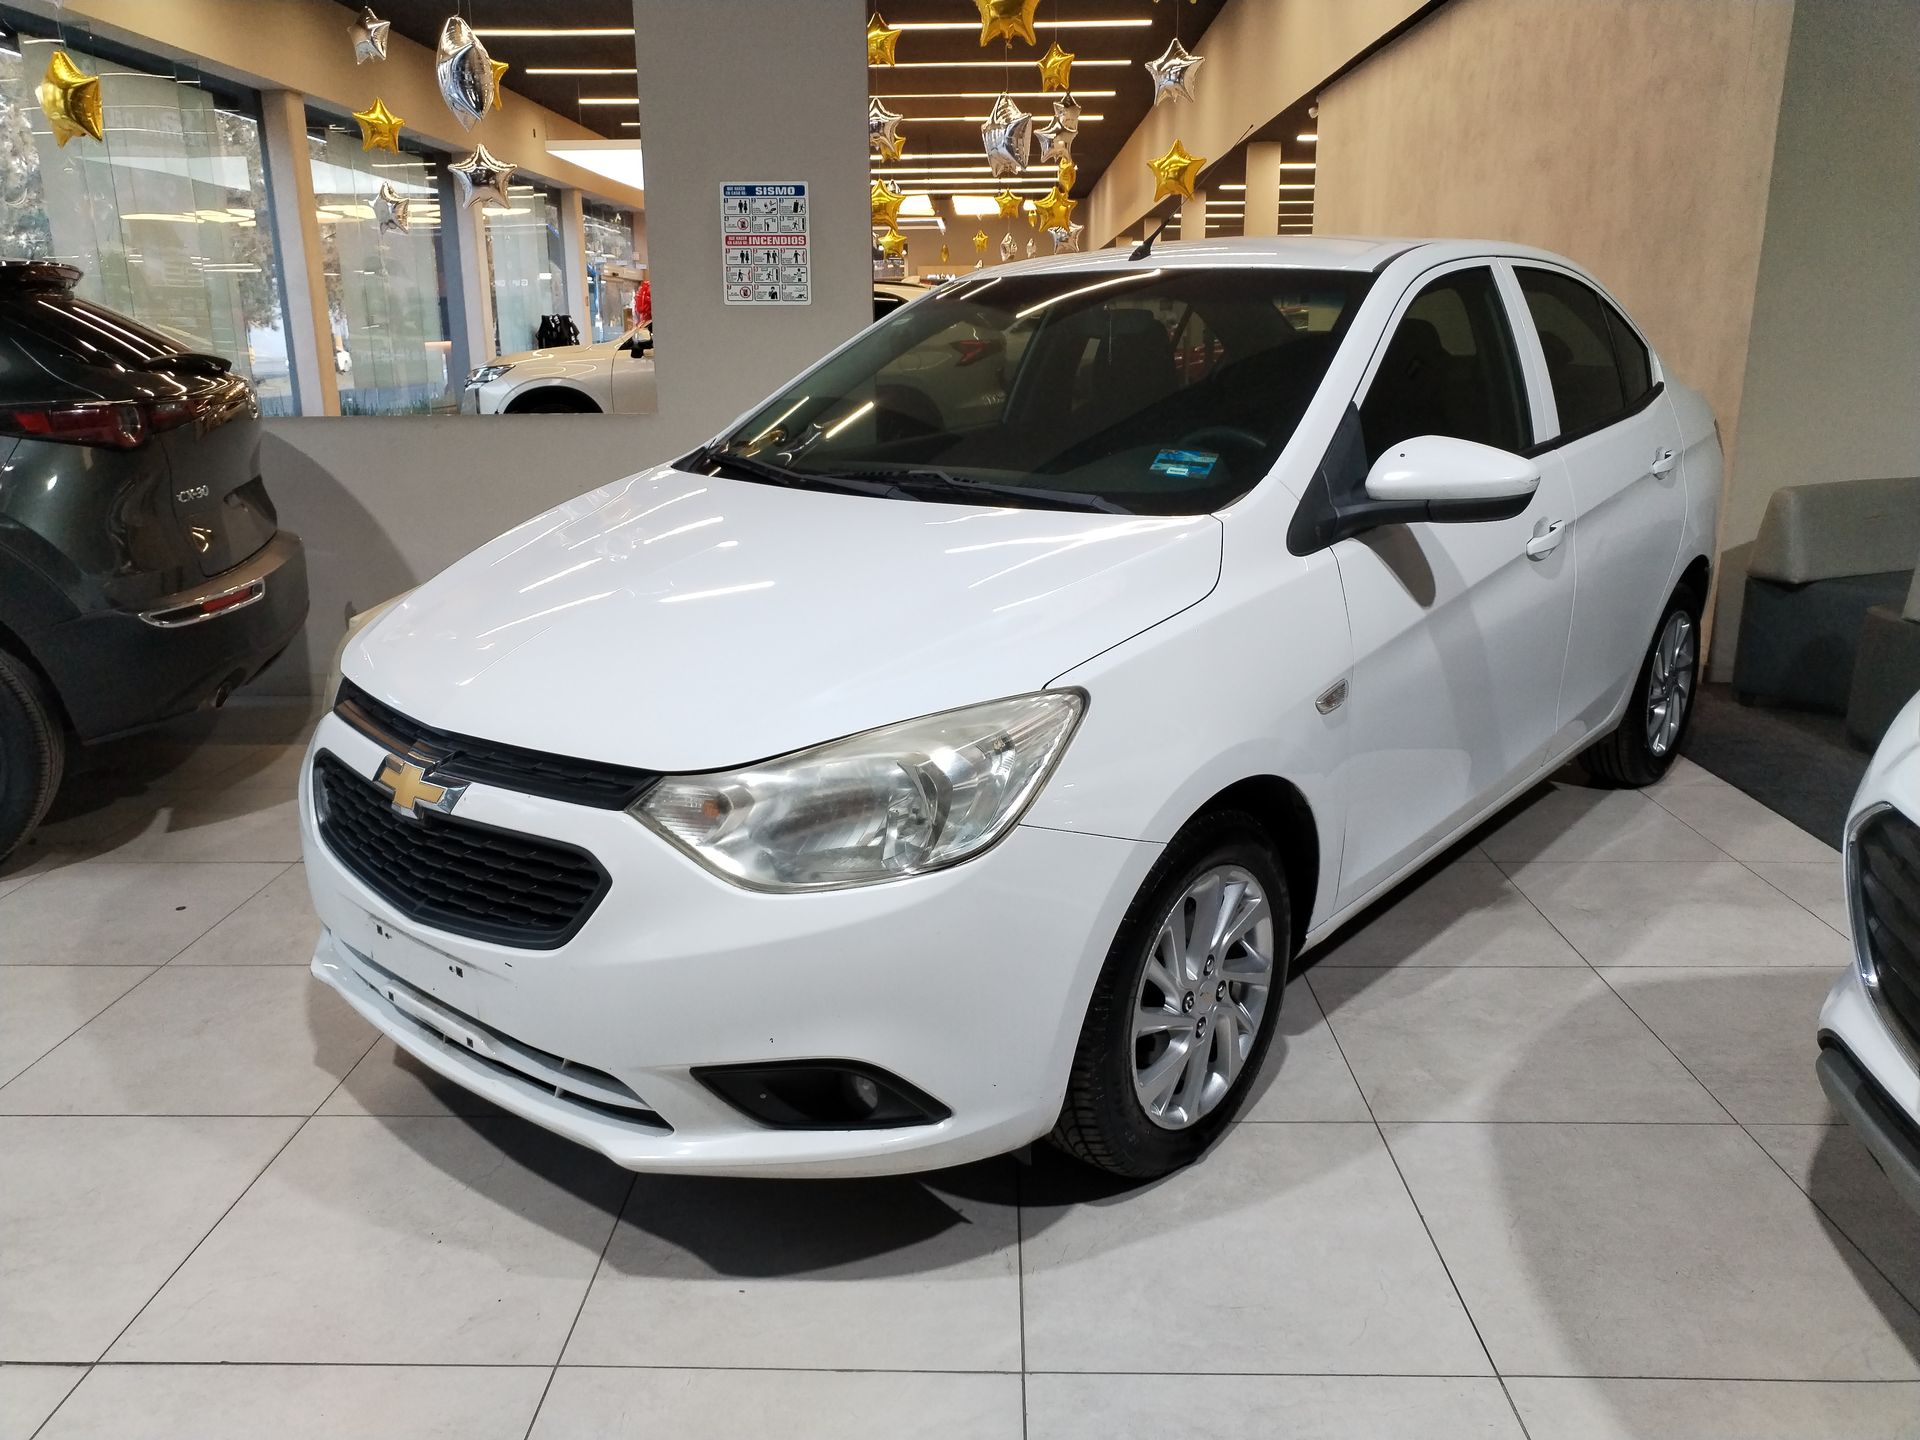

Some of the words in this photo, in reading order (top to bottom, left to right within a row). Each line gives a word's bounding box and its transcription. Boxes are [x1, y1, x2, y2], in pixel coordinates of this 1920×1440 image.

[755, 186, 796, 196] SISMO
[748, 236, 805, 245] INCENDIOS
[178, 484, 209, 503] CX-30
